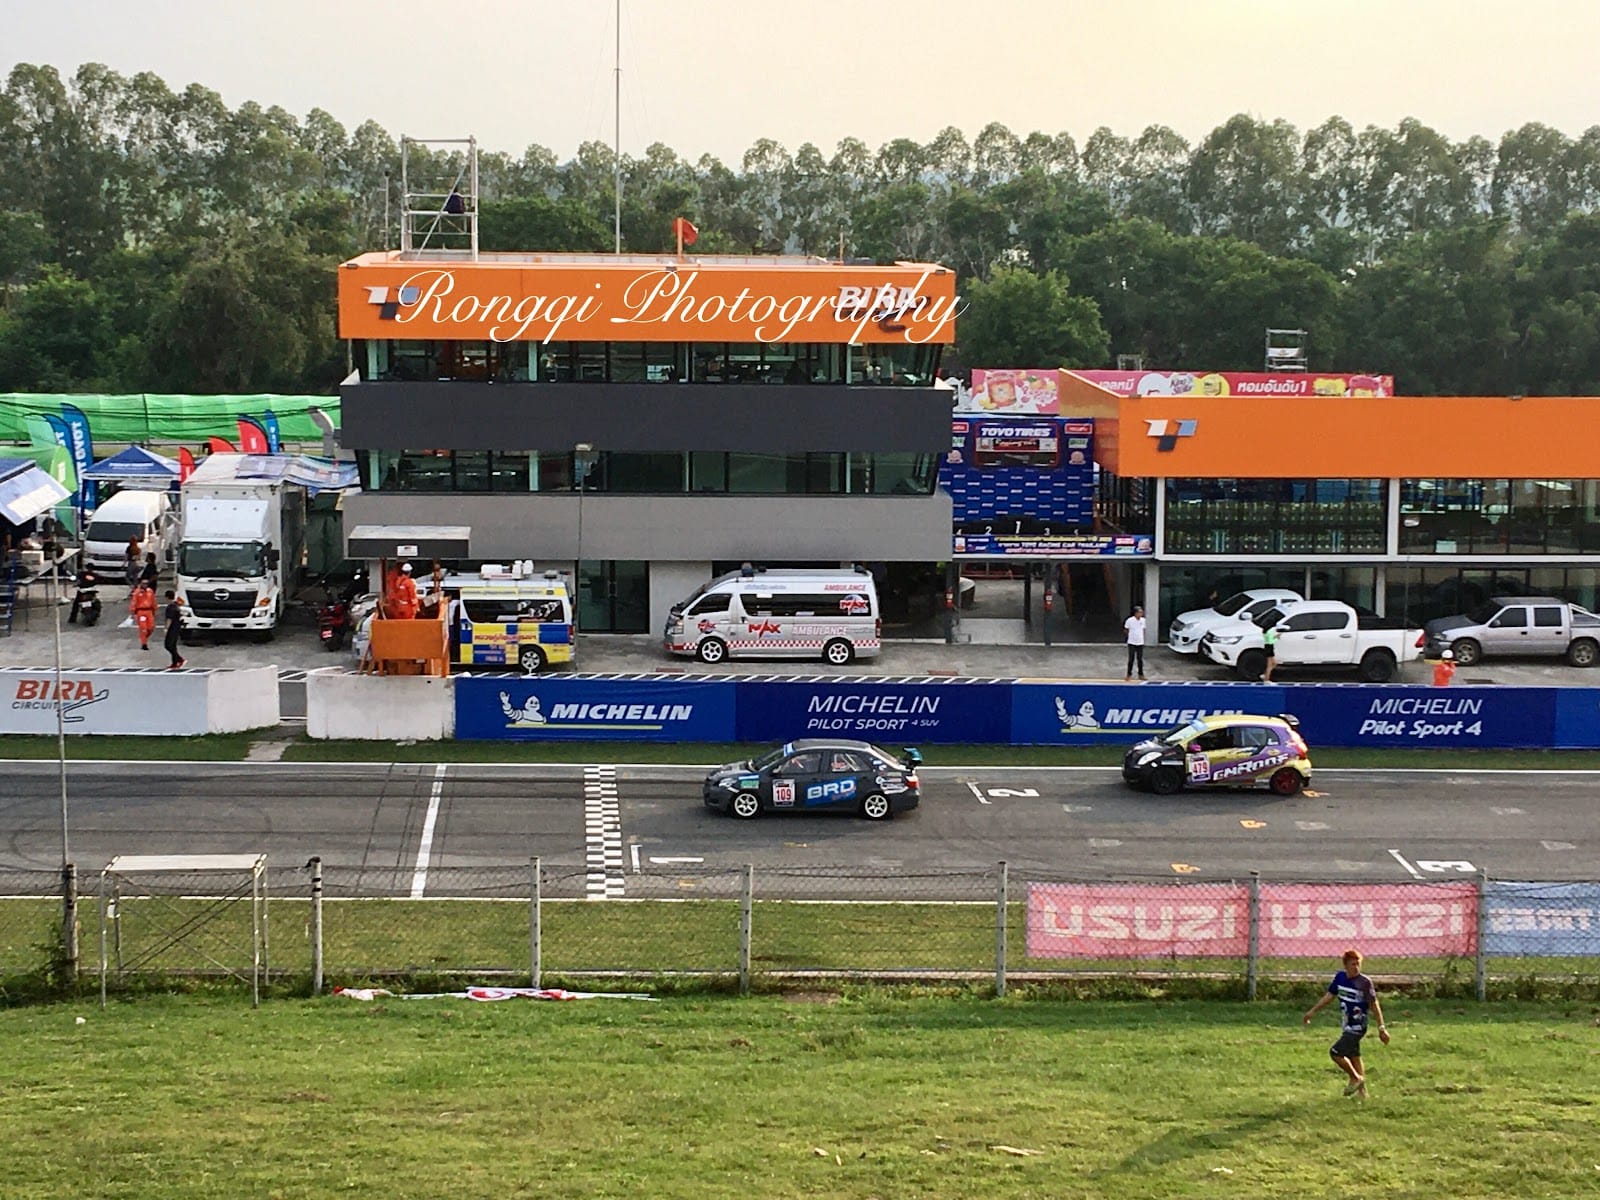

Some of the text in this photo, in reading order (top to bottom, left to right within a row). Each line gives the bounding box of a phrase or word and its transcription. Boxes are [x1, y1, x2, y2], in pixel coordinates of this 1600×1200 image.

[838, 286, 917, 309] BIRA
[981, 427, 1052, 437] TOYO TIRES
[985, 525, 992, 536] 2
[1015, 520, 1022, 534] 1
[1044, 527, 1050, 536] 3
[792, 624, 849, 635] AMBULANCE
[16, 679, 94, 700] BIRA
[550, 703, 693, 721] MICHELIN
[807, 695, 940, 714] MICHELIN
[1369, 698, 1482, 715] MICHELIN
[807, 718, 853, 730] PILOT
[855, 718, 908, 731] SPORT
[919, 719, 940, 727] SUV
[1359, 719, 1482, 739] Pilot Sport 4
[776, 788, 792, 801] 109
[807, 779, 855, 800] BRD
